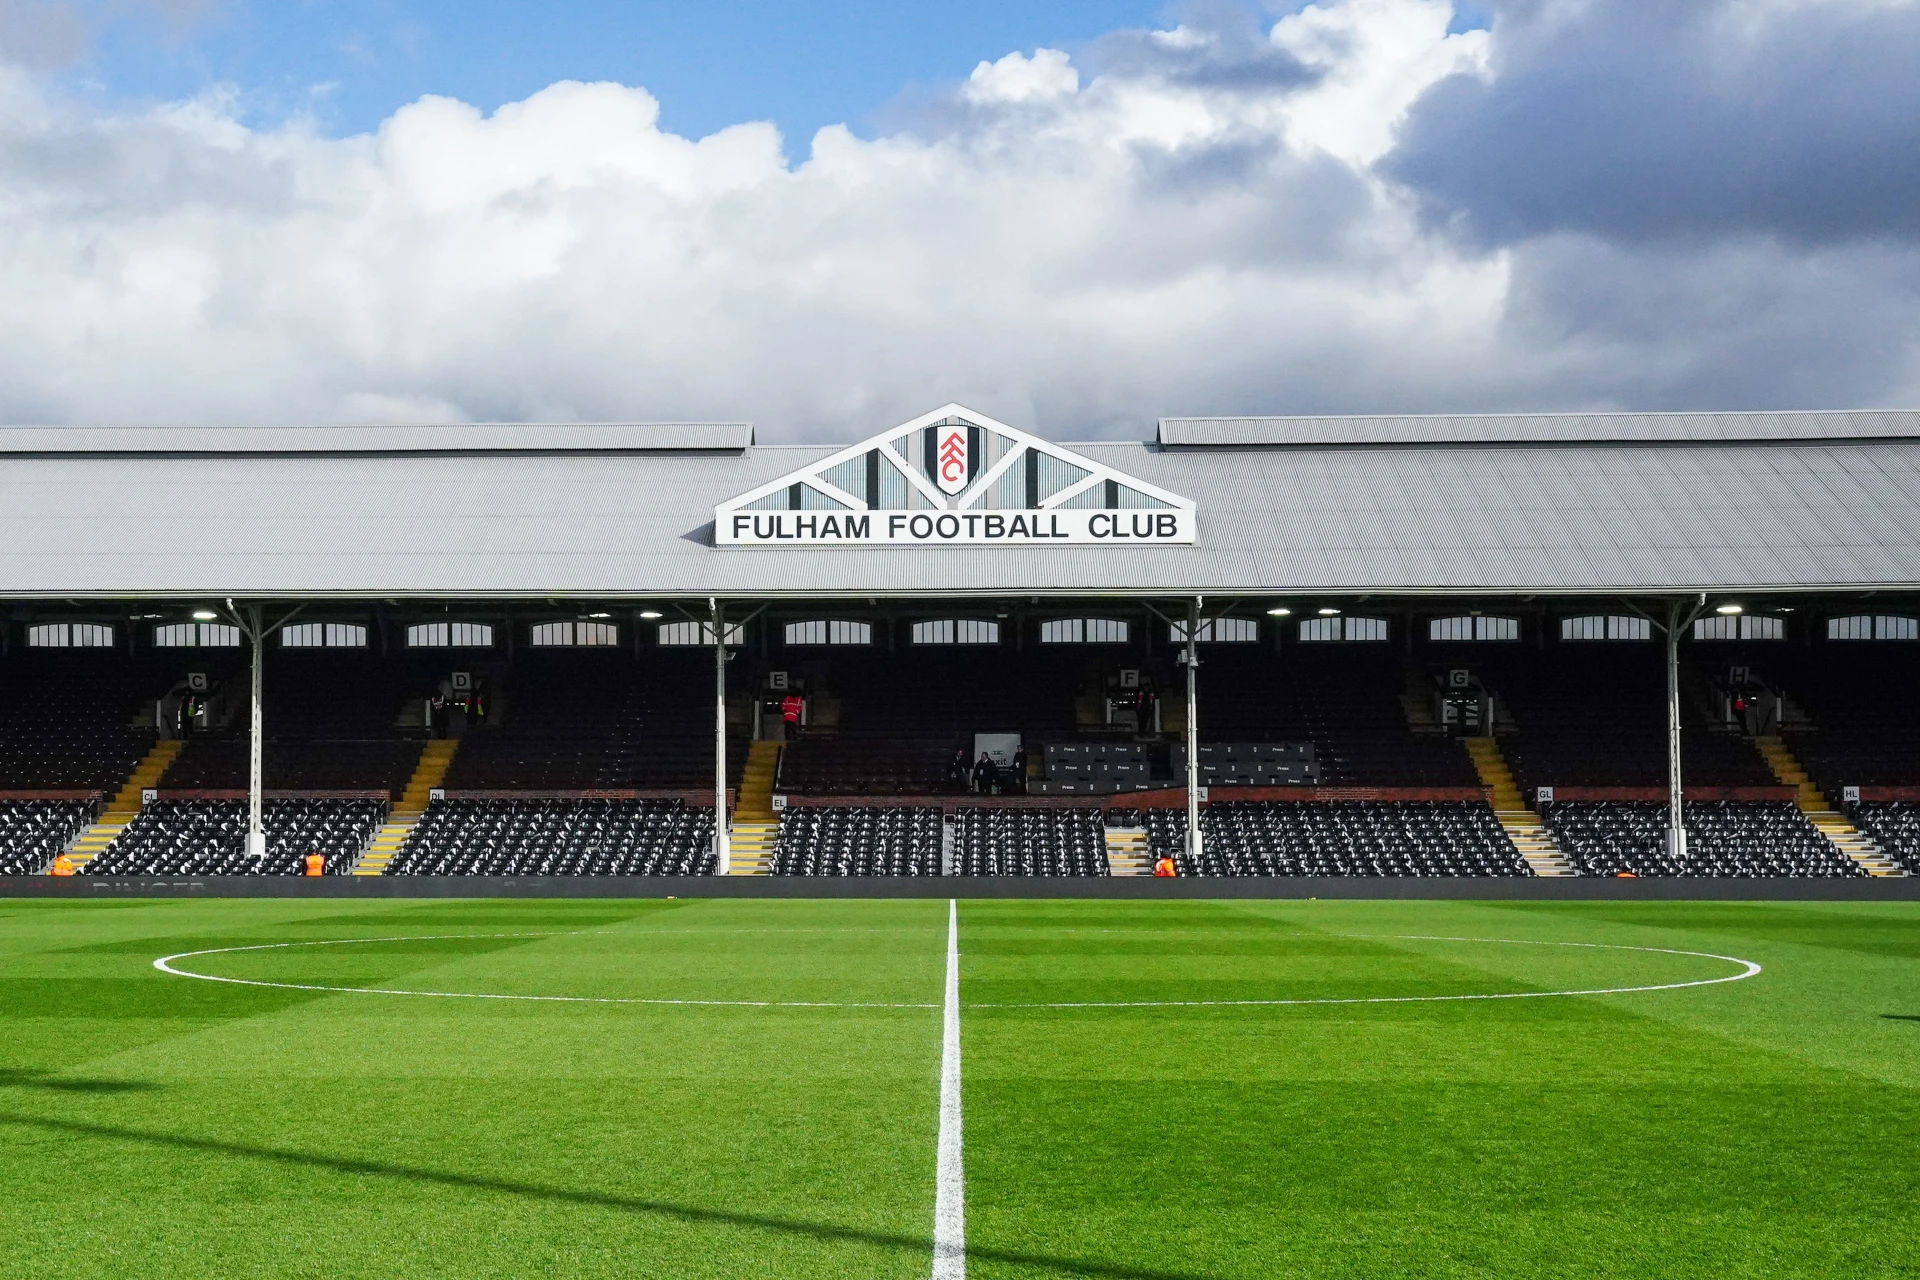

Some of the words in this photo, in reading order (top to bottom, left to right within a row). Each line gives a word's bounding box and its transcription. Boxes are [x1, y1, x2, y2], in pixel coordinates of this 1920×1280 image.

[733, 515, 870, 539] FULHAM
[889, 514, 1069, 539] FOOTBALL
[1088, 513, 1178, 539] CLUB
[192, 675, 203, 687] C
[456, 675, 467, 686] D
[774, 674, 784, 686] E
[1125, 672, 1134, 684] F
[1453, 672, 1465, 684] G
[1732, 668, 1746, 683] H
[1539, 790, 1551, 798] GL
[1845, 790, 1858, 798] HL
[774, 799, 785, 807] EL
